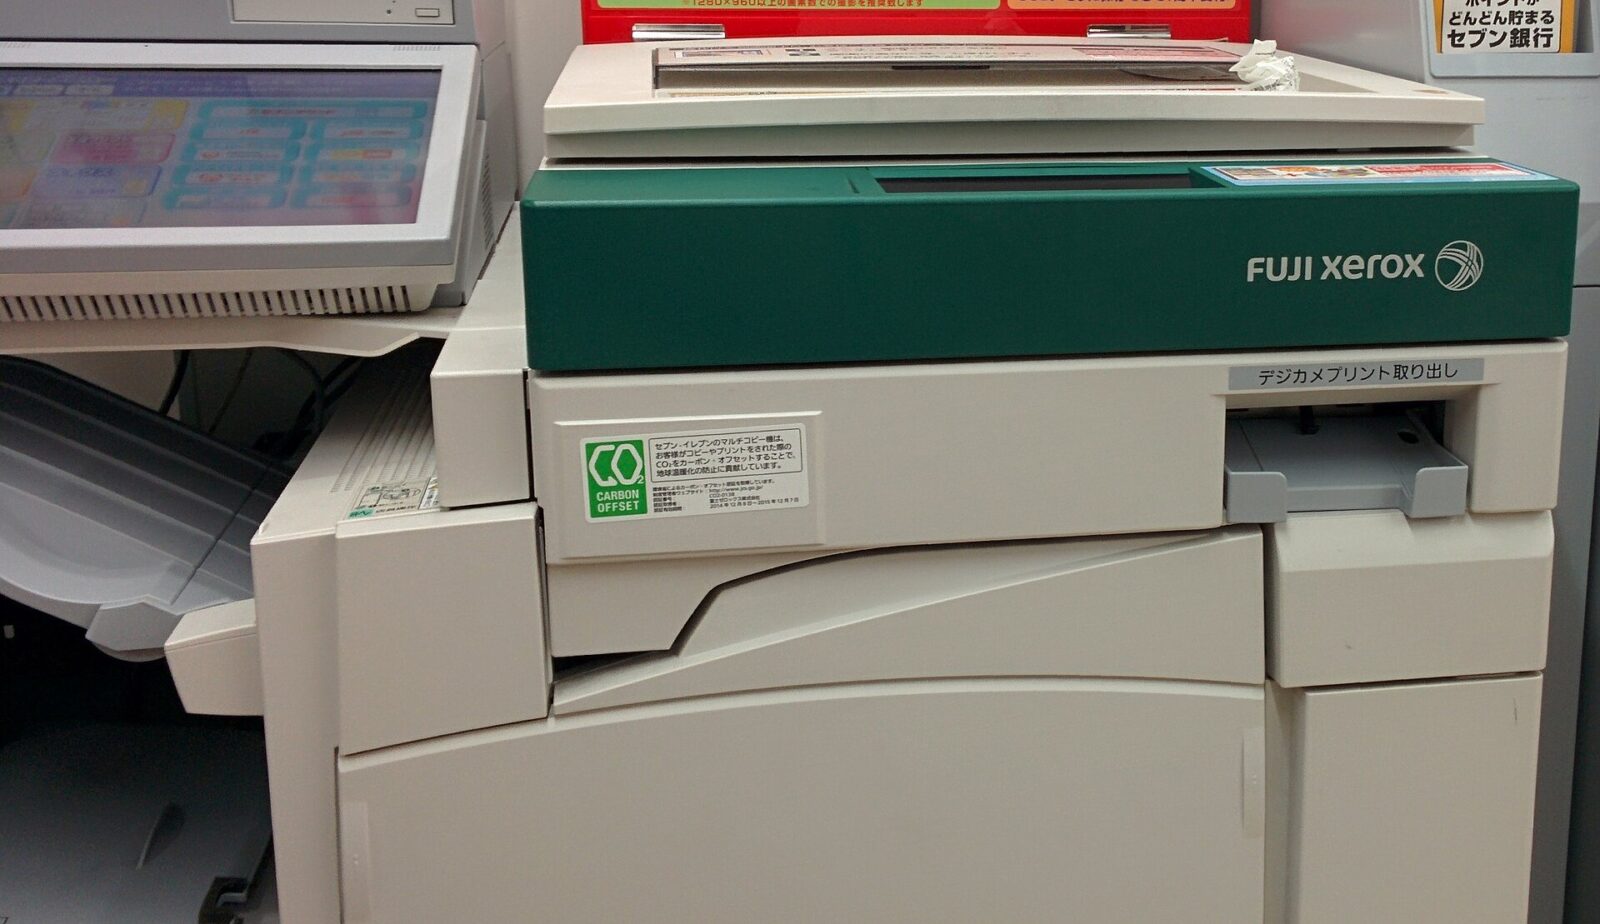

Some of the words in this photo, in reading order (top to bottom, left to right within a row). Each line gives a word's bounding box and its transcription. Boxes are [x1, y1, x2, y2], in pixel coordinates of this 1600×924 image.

[1449, 10, 1555, 26] どんどん貯まる
[1447, 27, 1554, 48] セブン銀行
[1247, 256, 1312, 282] FUJI
[1320, 253, 1425, 280] xerox
[1258, 362, 1459, 386] デジカメプリント取り出し
[655, 443, 792, 460] お客様がコピーやプリントをされた際の
[656, 461, 782, 478] 地球温暖化の防止に貢献しています。
[596, 489, 640, 501] CARBON
[597, 500, 640, 513] OFFSET
